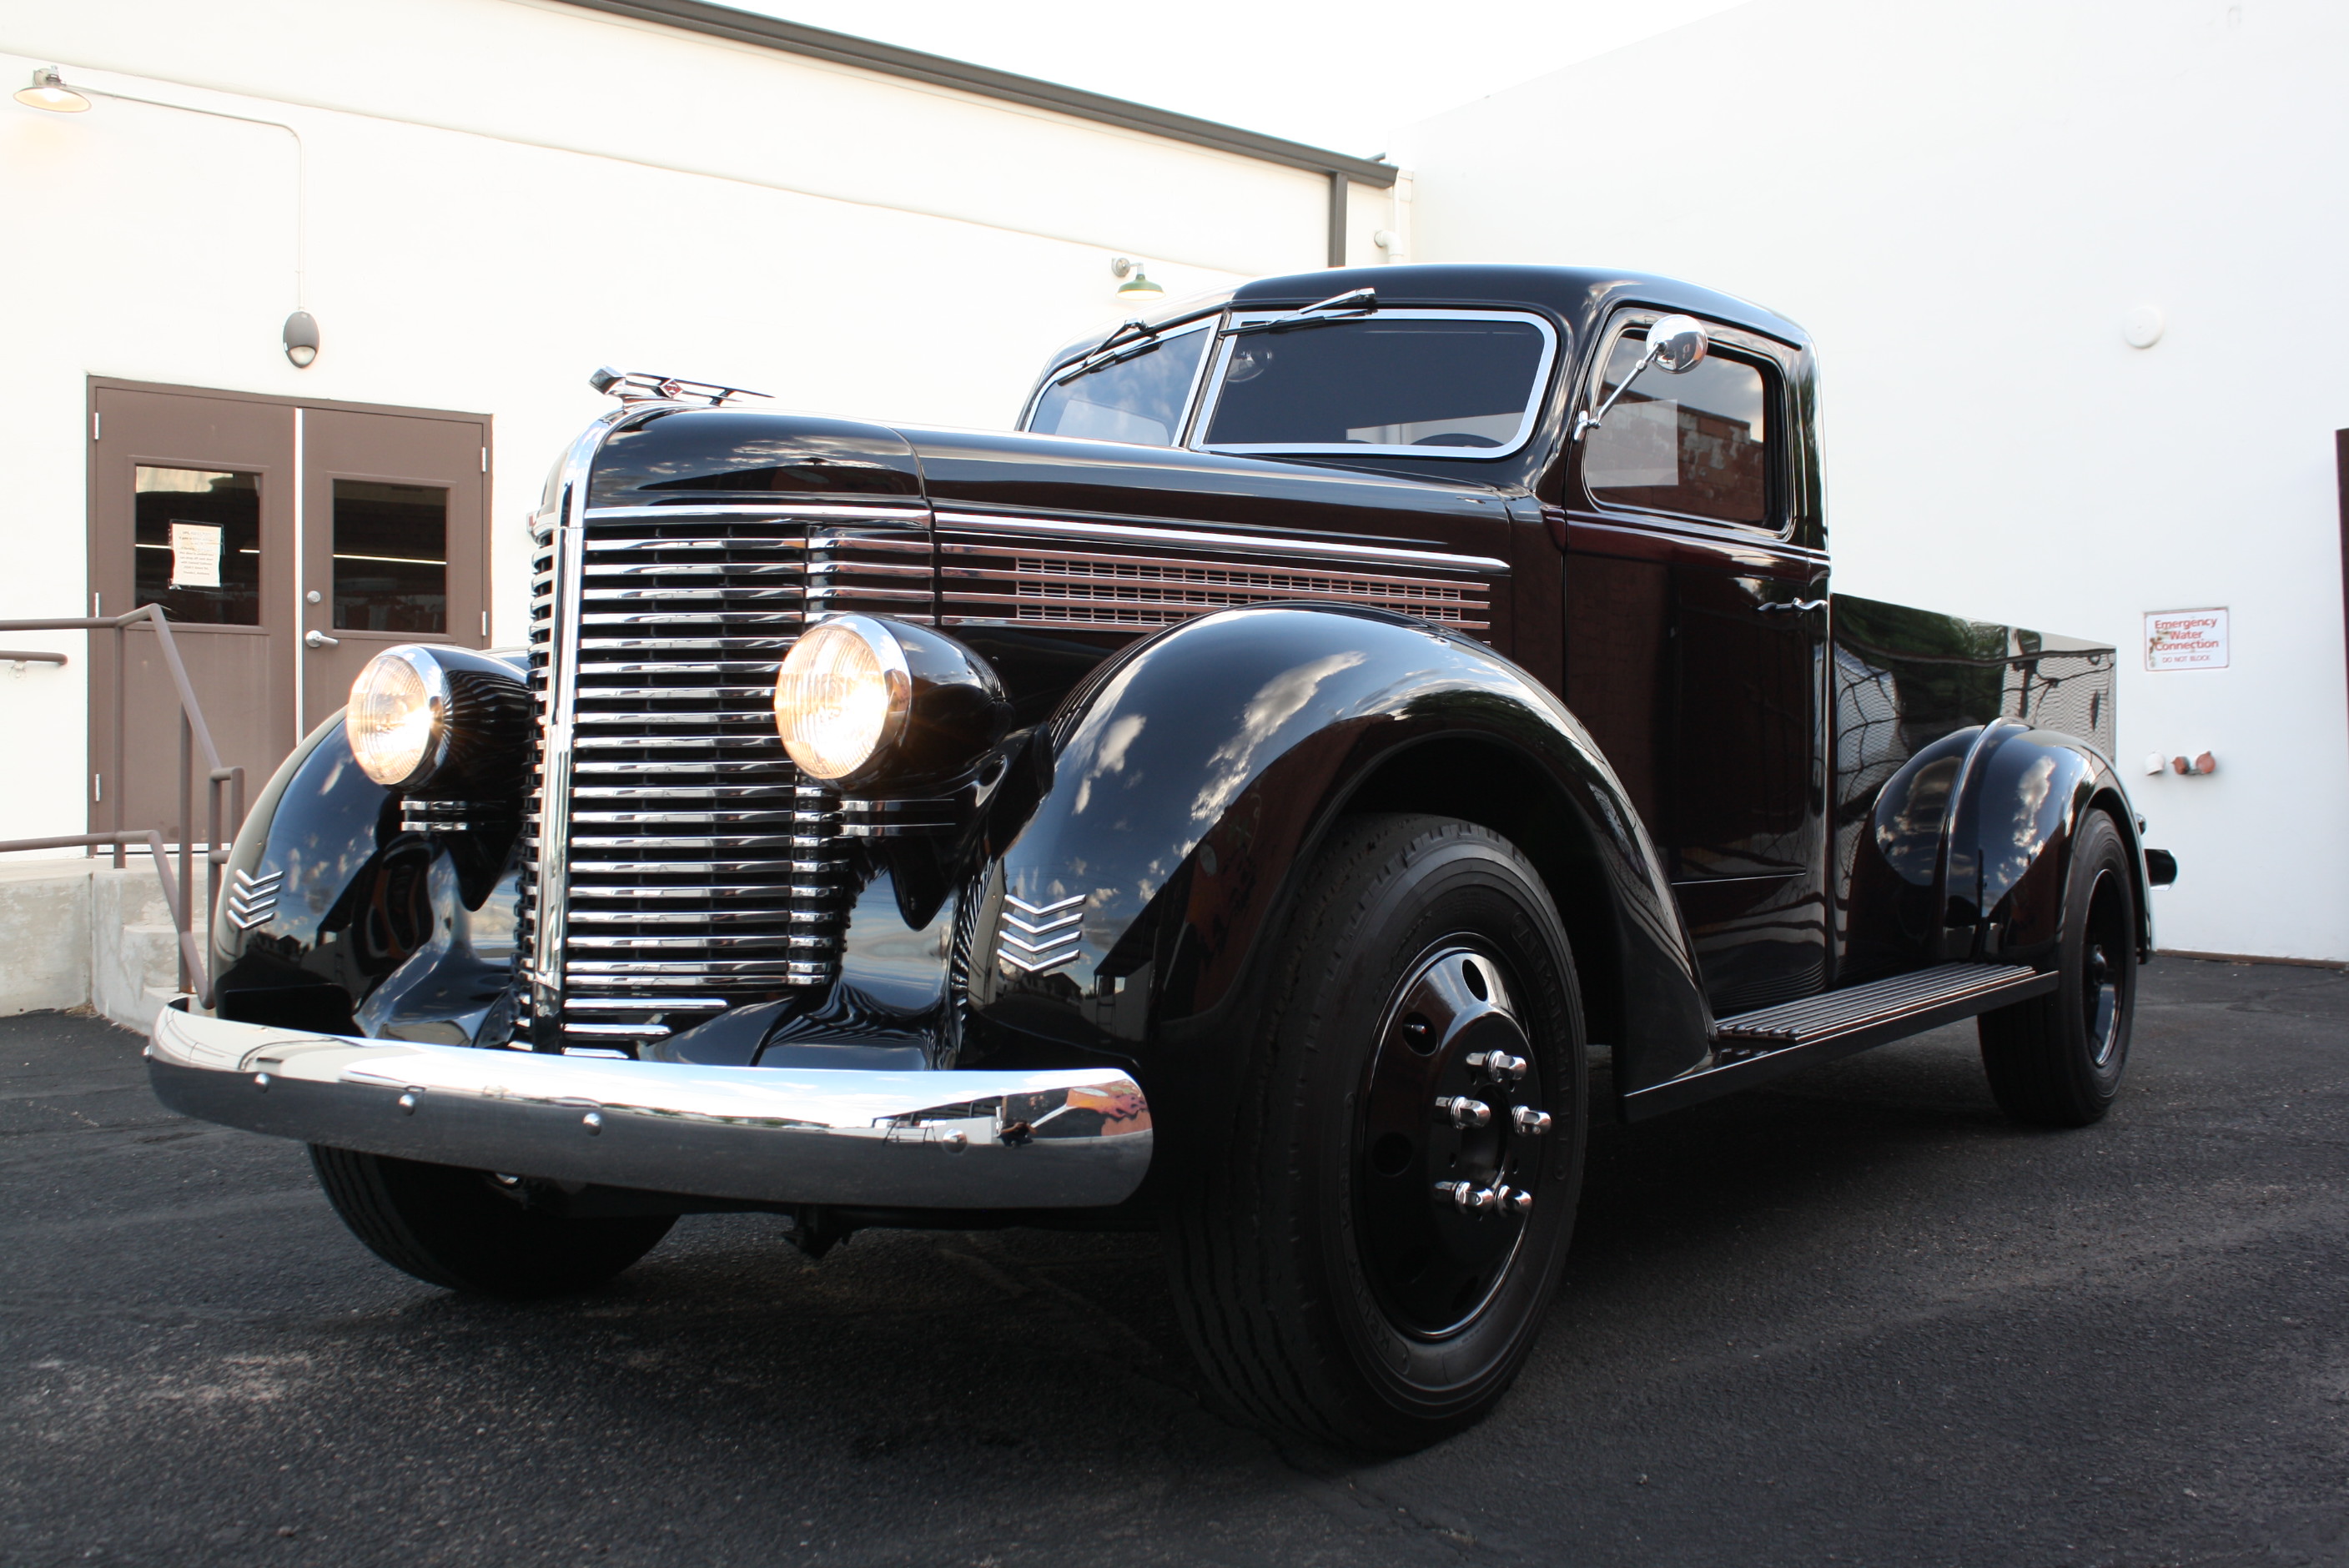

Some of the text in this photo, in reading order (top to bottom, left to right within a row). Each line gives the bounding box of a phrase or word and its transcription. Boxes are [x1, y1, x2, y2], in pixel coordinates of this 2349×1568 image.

[2155, 618, 2217, 630] Emergency
[2170, 631, 2203, 640] Water
[2155, 641, 2219, 651] Connection
[1348, 1257, 1391, 1354] KELLY
